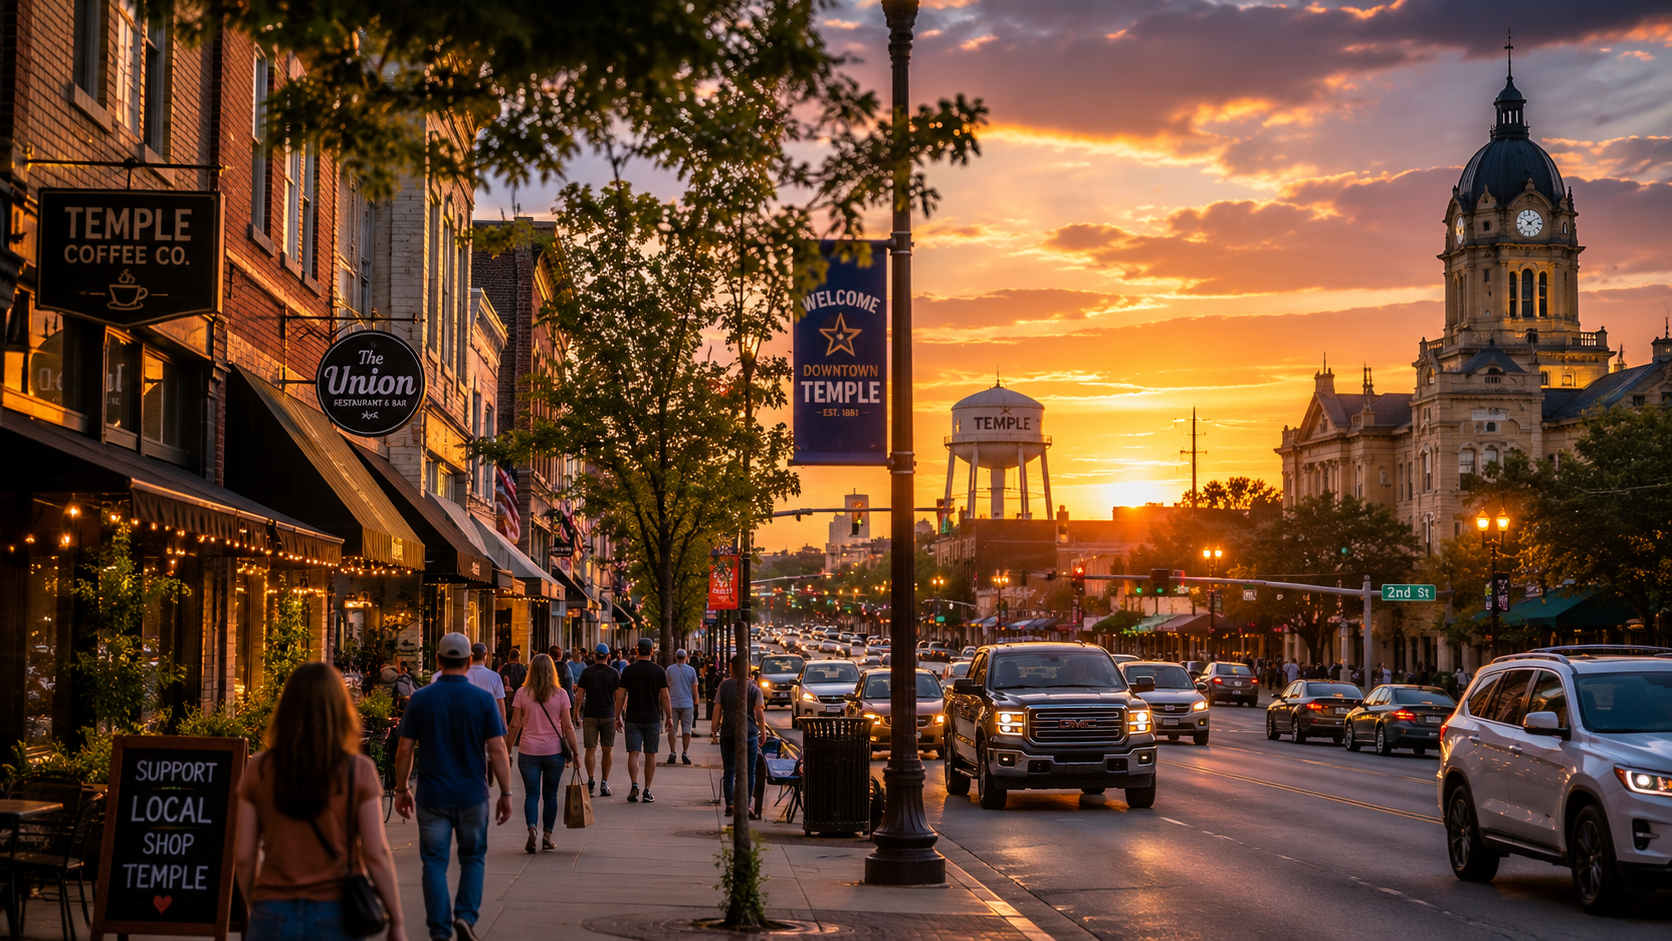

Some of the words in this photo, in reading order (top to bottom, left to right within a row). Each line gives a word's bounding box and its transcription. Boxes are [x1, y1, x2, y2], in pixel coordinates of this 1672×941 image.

[64, 206, 192, 241] TEMPLE
[64, 244, 147, 265] COFFEE
[155, 246, 190, 266] CO.
[801, 289, 880, 314] WELCOME
[358, 349, 384, 365] The
[324, 365, 417, 396] Union
[803, 364, 879, 377] DOWNTOWN
[391, 398, 407, 408] BAR
[800, 380, 881, 404] TEMPLE
[823, 408, 840, 417] EST.
[842, 408, 859, 417] 1881
[973, 416, 1031, 431] TEMPLE
[1387, 586, 1411, 599] 2nd
[1417, 587, 1430, 599] St
[135, 760, 218, 783] SUPPORT
[131, 795, 212, 824] LOCAL
[142, 833, 195, 856] SHOP
[122, 863, 209, 890] TEMPLE
